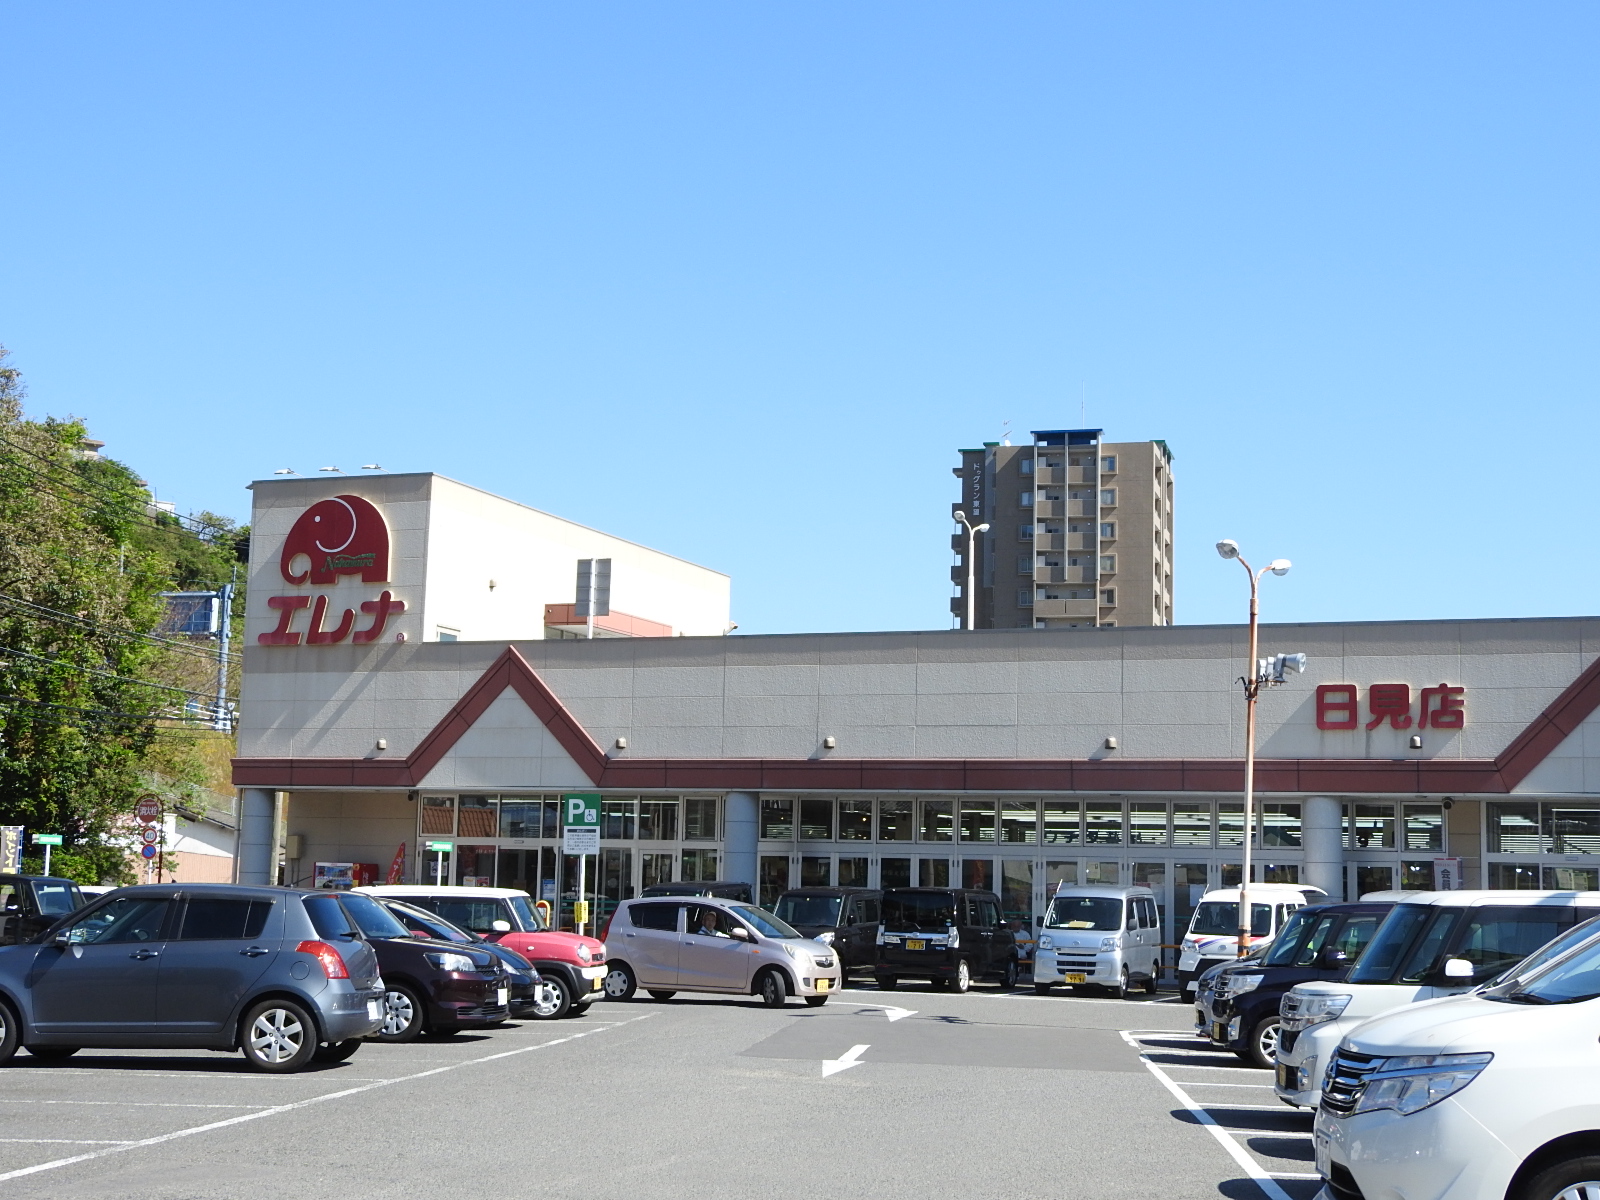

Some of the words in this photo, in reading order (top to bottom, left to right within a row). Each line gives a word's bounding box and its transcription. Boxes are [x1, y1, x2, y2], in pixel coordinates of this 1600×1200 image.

[257, 590, 407, 645] エレナ
[1315, 683, 1466, 731] 日見店
[139, 806, 158, 816] 消火栓
[568, 798, 586, 824] P
[145, 832, 155, 840] 40
